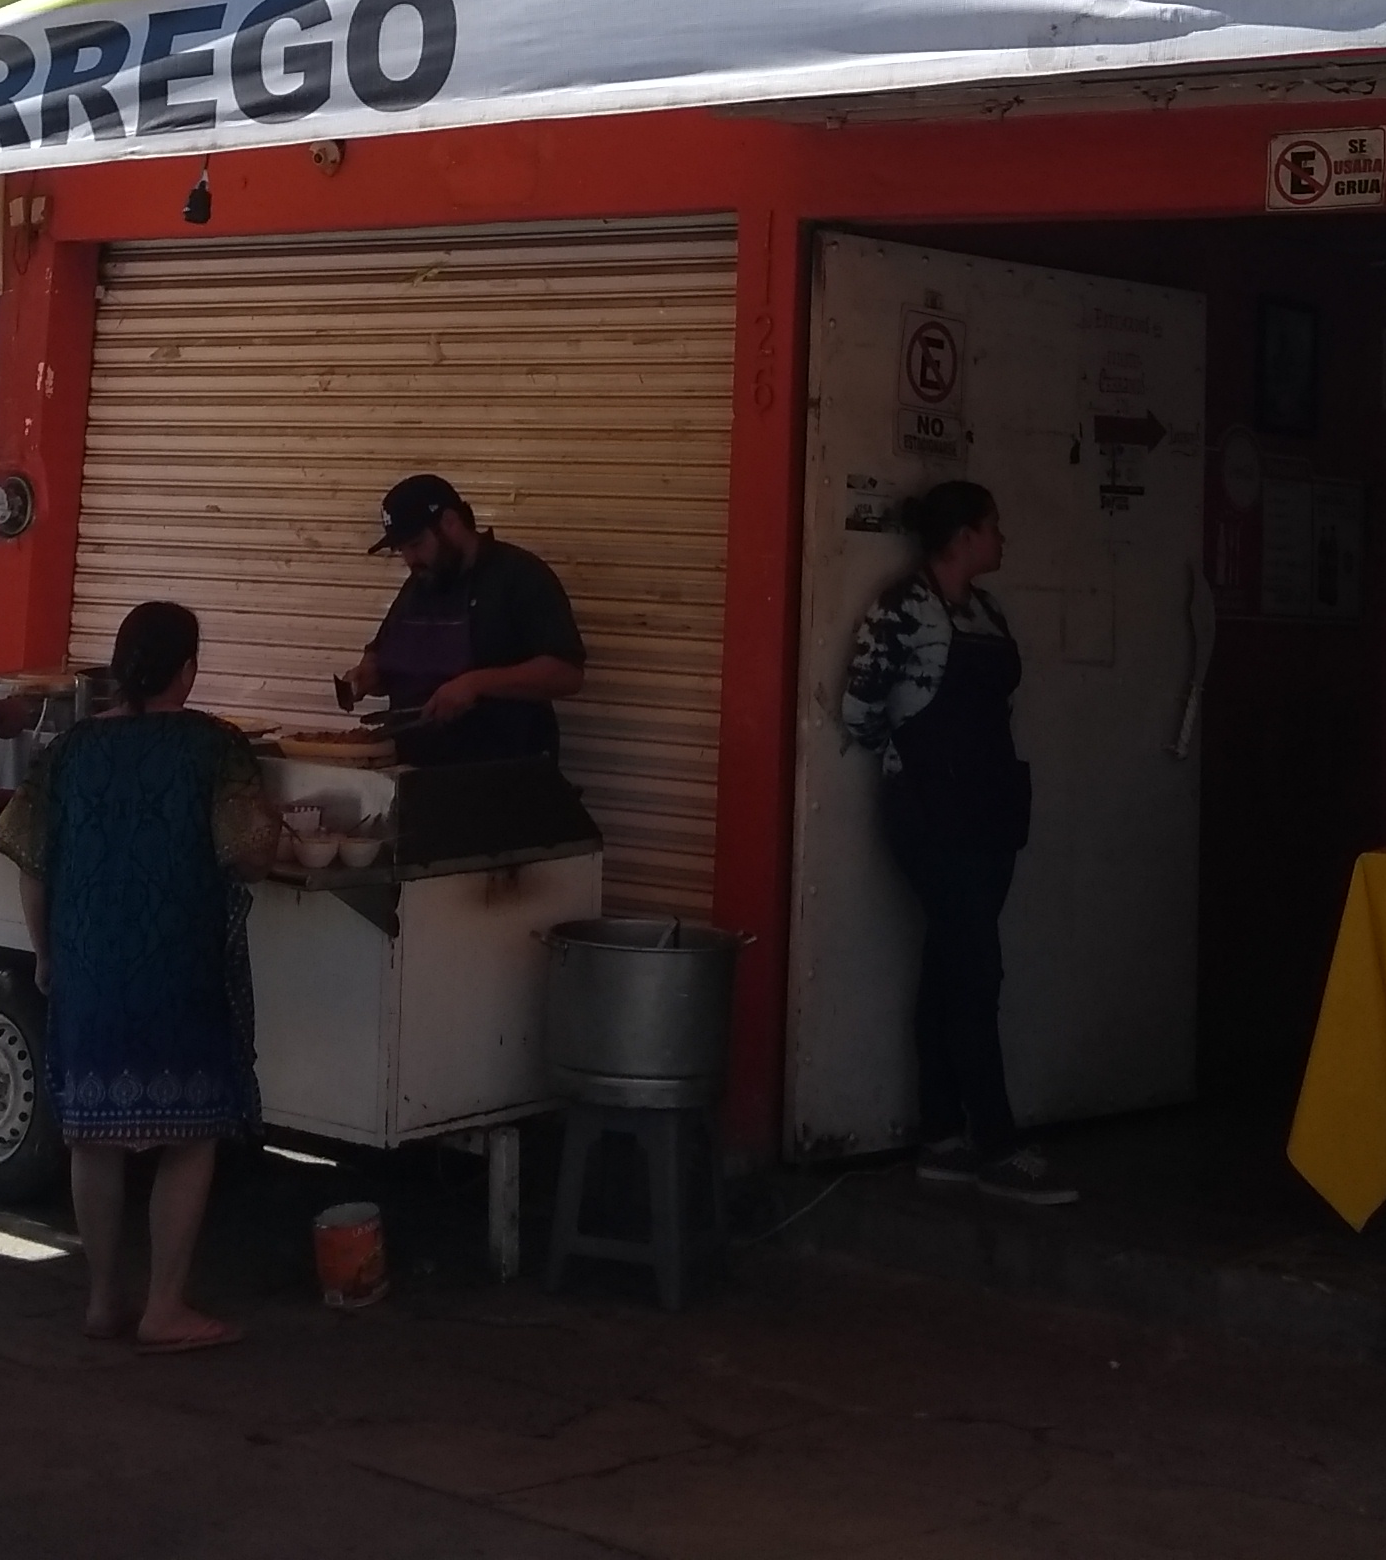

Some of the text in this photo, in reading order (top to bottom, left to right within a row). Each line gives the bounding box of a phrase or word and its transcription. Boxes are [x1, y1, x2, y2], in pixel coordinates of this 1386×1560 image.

[1348, 138, 1367, 154] SE
[1333, 158, 1382, 176] USARA
[1334, 178, 1381, 196] GRUA
[916, 414, 945, 438] NO
